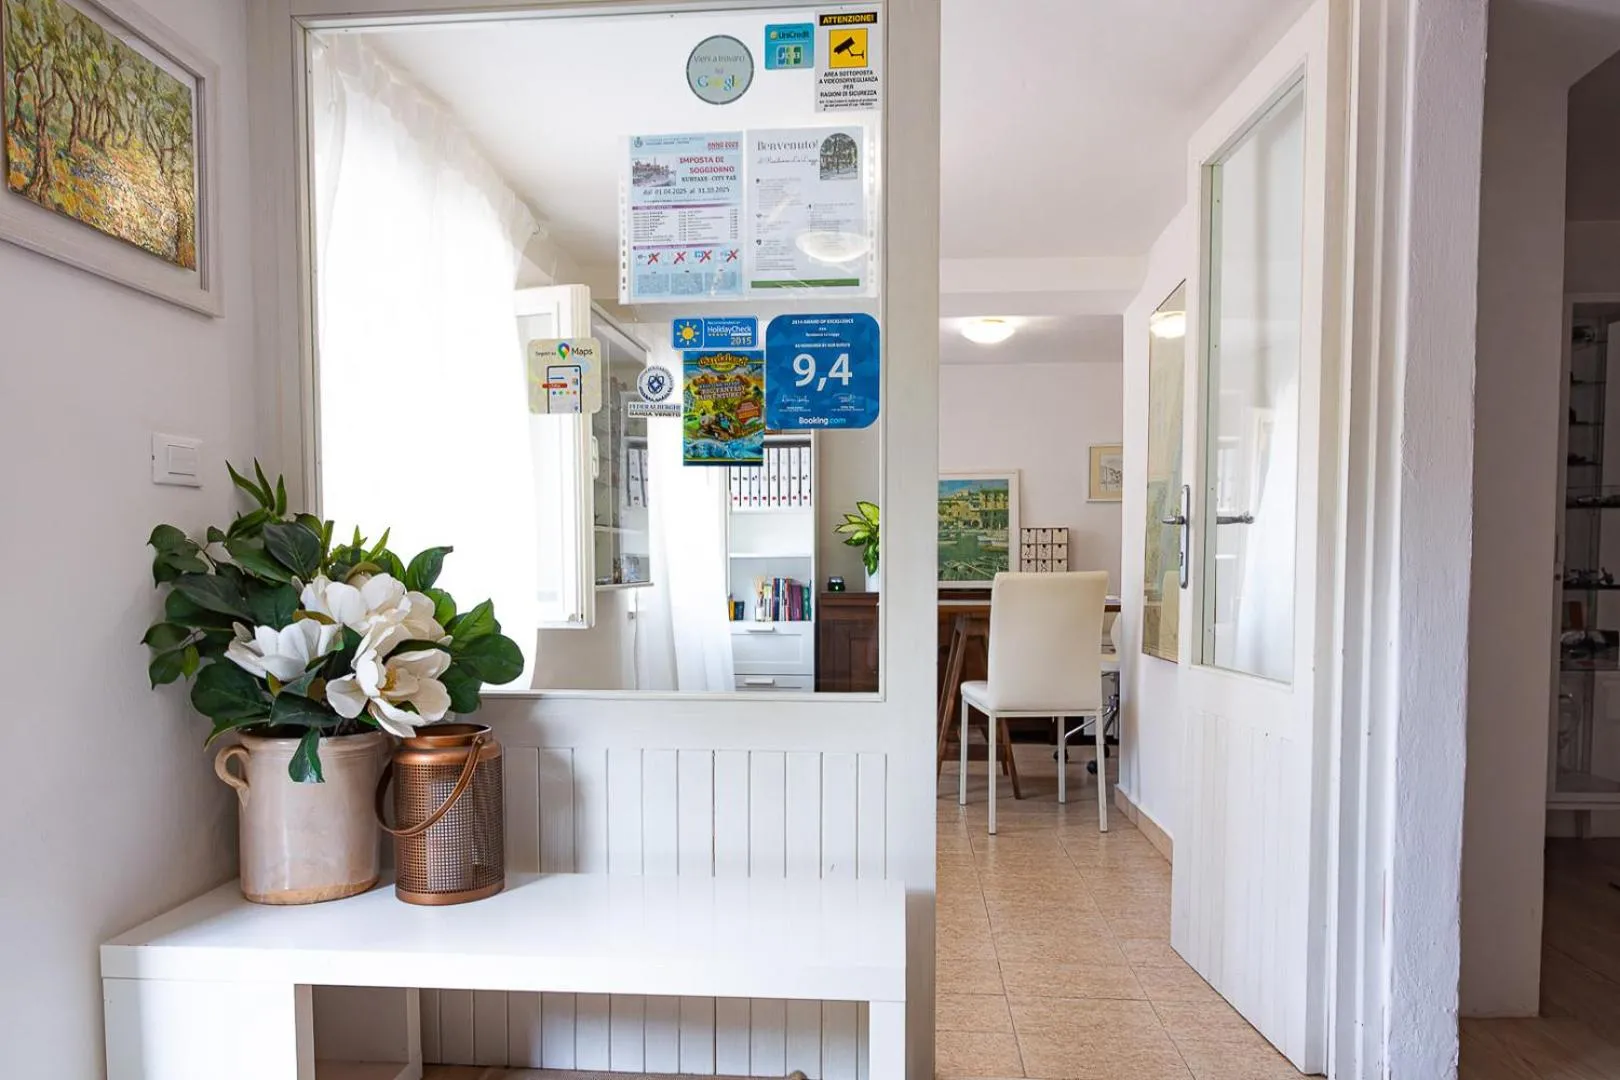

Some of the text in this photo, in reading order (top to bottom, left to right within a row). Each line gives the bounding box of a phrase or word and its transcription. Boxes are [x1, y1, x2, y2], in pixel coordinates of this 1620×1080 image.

[822, 14, 875, 24] ATTENZIONE!
[778, 31, 810, 40] UniCredit
[757, 140, 818, 151] Benvenuto!
[689, 166, 735, 174] SOGGIORNO
[708, 325, 752, 335] HolidayCheck
[731, 337, 752, 345] 2015
[572, 348, 593, 358] Maps
[792, 353, 853, 392] 9,4
[798, 416, 846, 426] Booking.com
